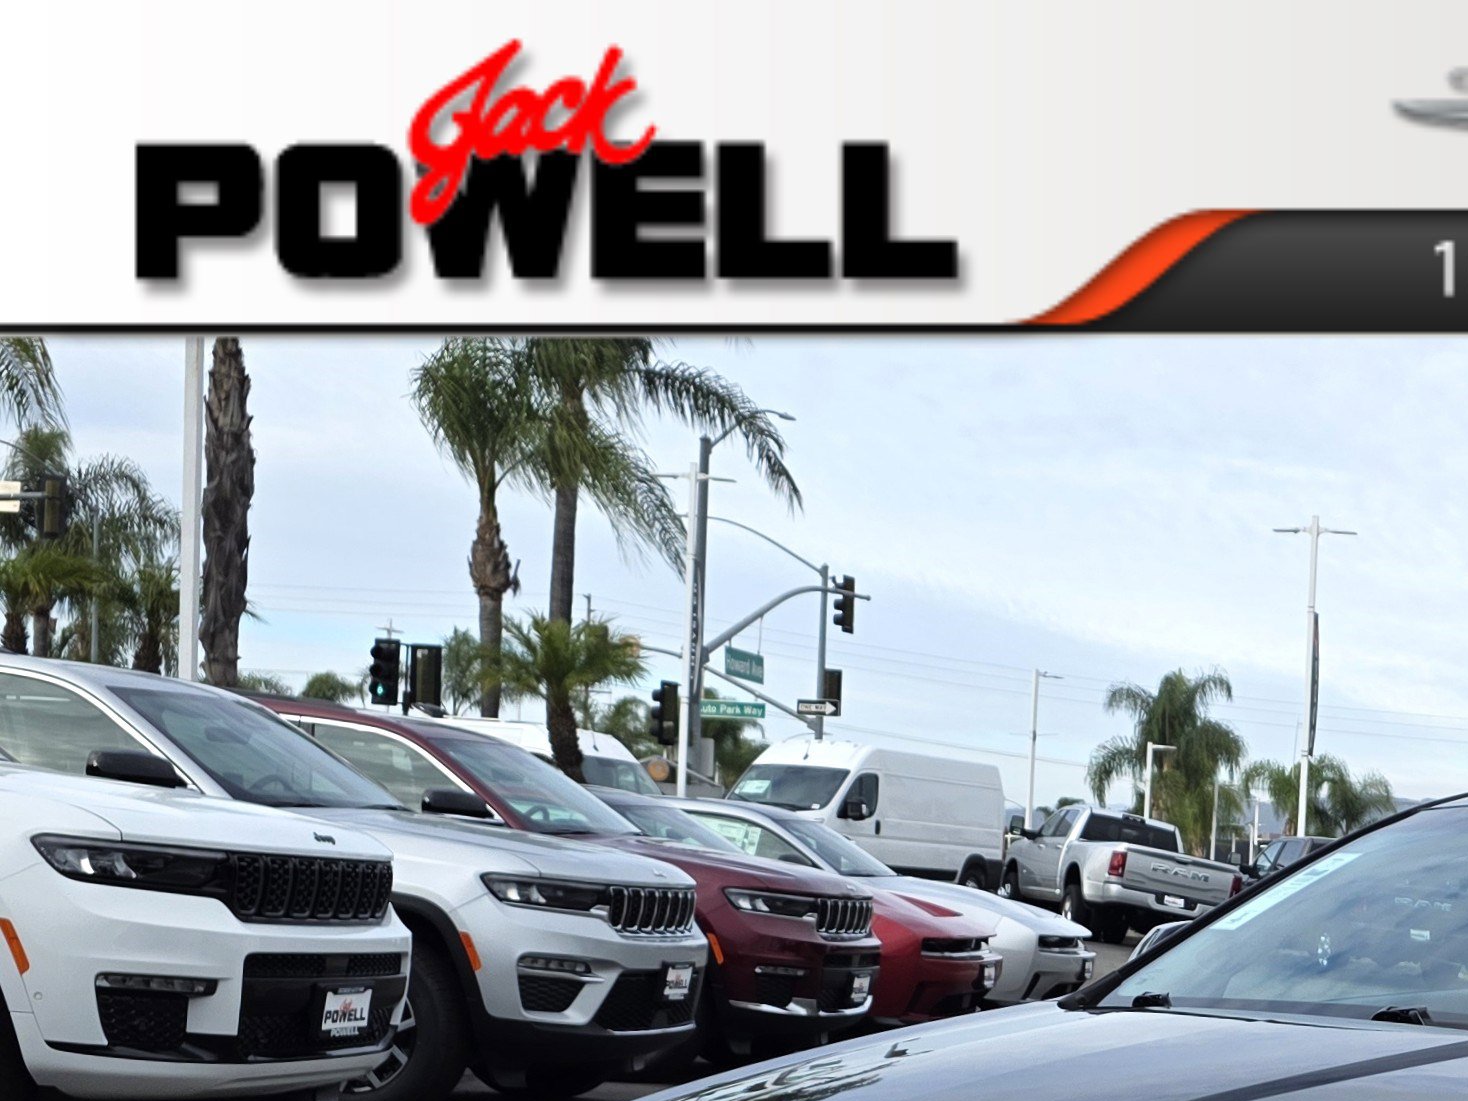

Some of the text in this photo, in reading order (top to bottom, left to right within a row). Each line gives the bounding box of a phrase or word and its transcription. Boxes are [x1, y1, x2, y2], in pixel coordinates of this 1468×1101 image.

[701, 704, 763, 717] uto Park Way
[1151, 862, 1210, 882] RAM
[324, 1007, 366, 1024] POWELL
